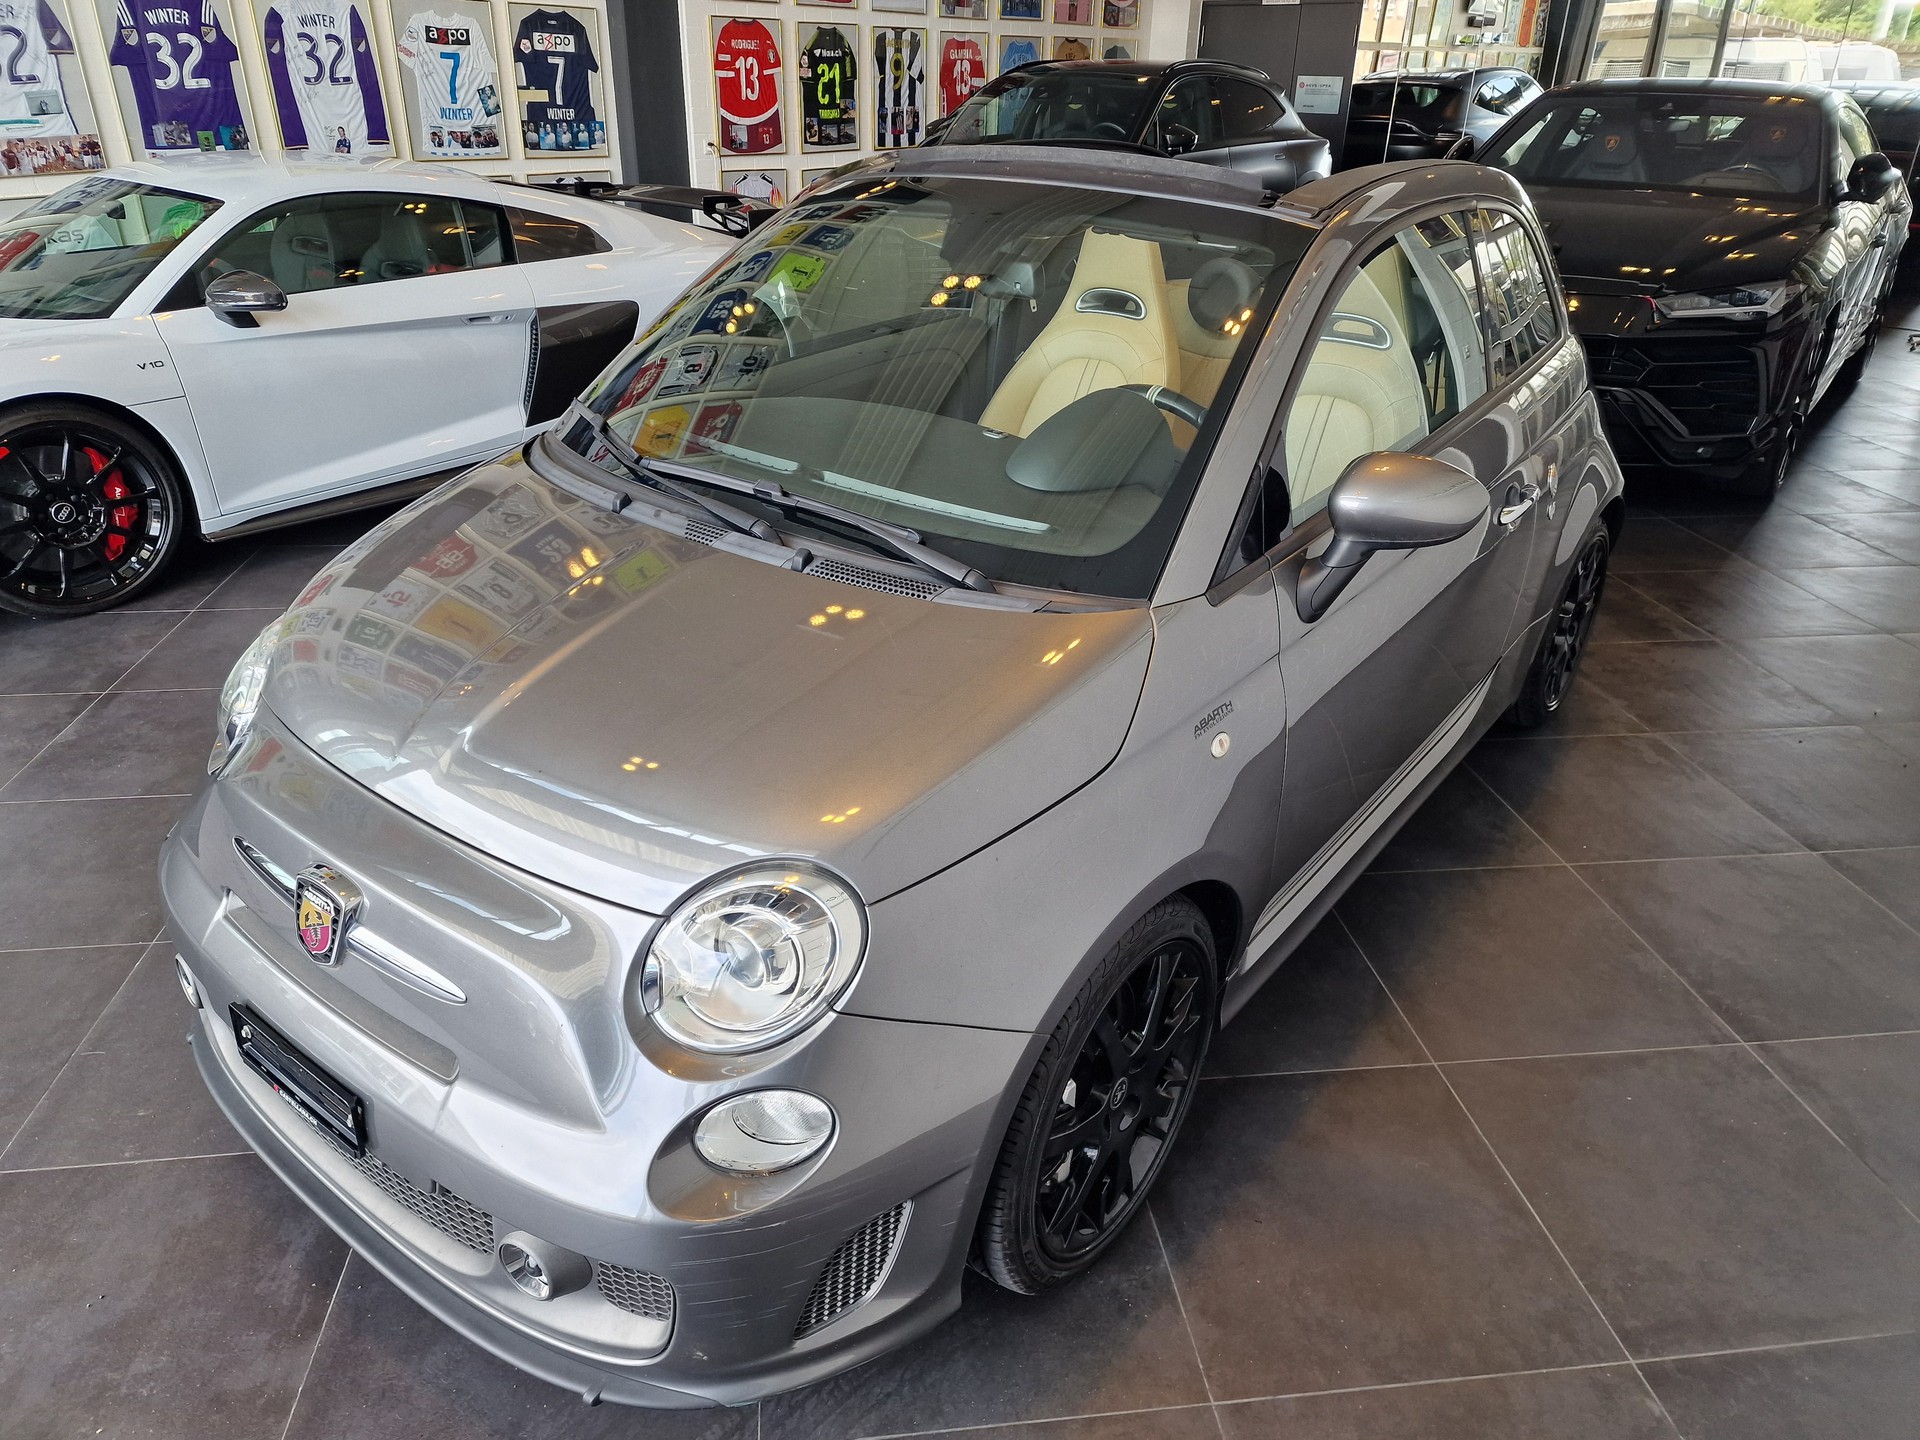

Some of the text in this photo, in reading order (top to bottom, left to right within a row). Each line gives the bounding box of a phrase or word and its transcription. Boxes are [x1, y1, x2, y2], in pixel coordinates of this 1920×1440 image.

[144, 8, 190, 26] WINTER
[297, 13, 335, 29] WINTER
[0, 25, 41, 85] 2
[146, 32, 211, 89] 32
[297, 32, 353, 86] 32
[731, 39, 759, 50] RODRIGUEZ
[950, 48, 972, 59] GAMBIA
[440, 52, 460, 104] 7
[547, 55, 565, 105] 7
[735, 56, 759, 100] 13
[817, 62, 840, 104] 21
[890, 53, 904, 91] 9
[953, 60, 970, 95] 13
[440, 106, 473, 120] WINTER
[547, 108, 575, 121] WINTER
[763, 133, 770, 145] 13
[136, 360, 165, 370] V10
[1194, 700, 1233, 735] ABARTH
[304, 889, 332, 914] ABARTH
